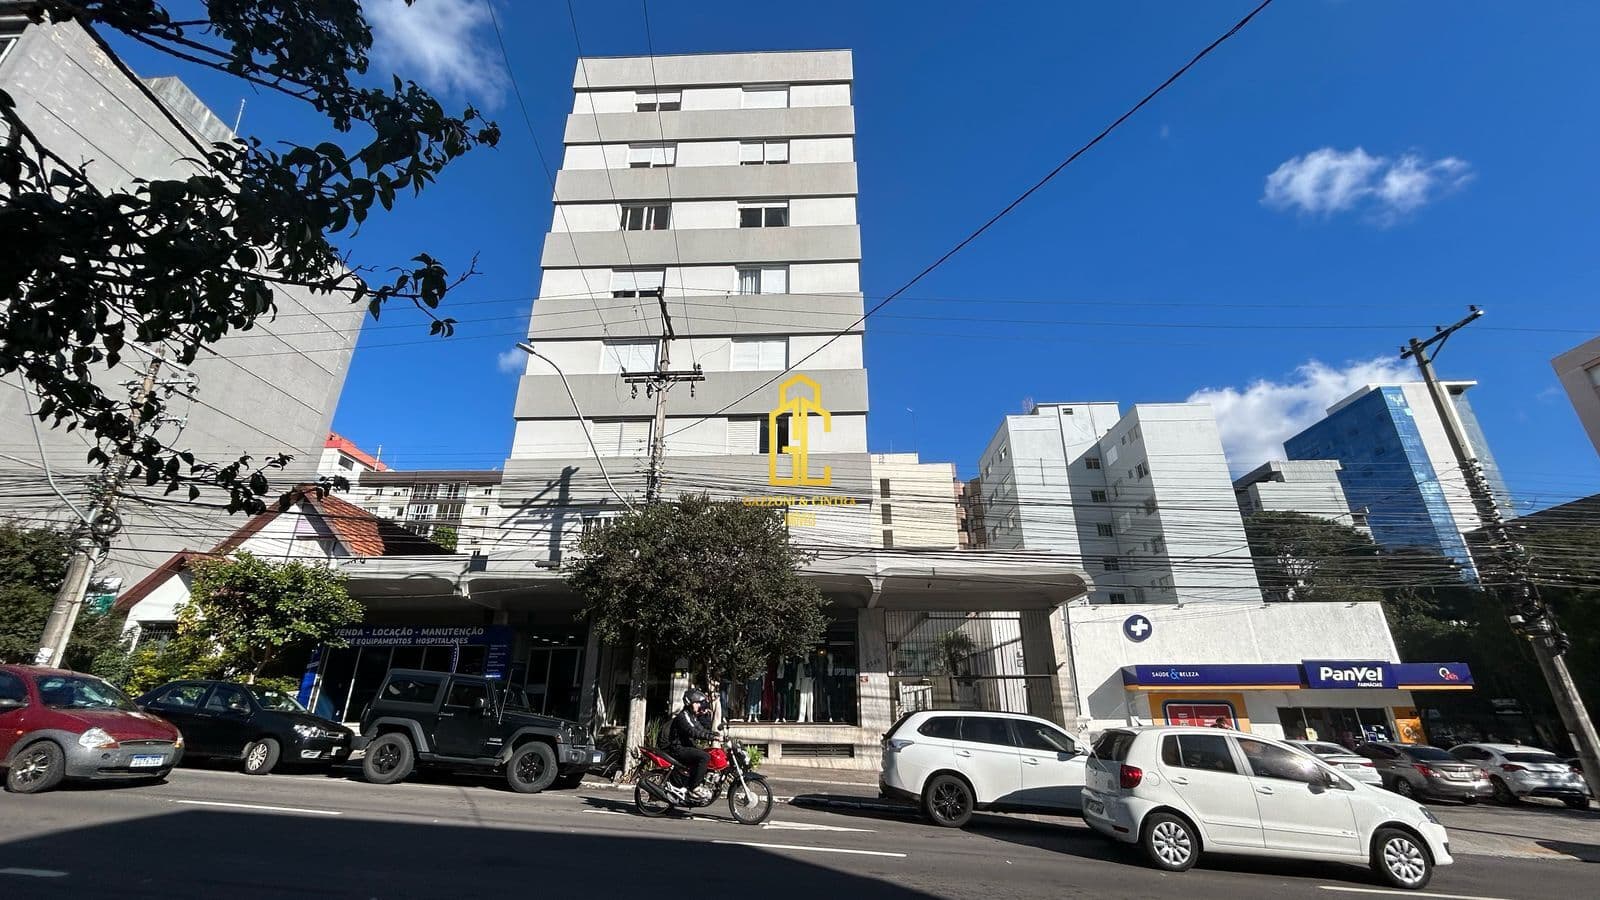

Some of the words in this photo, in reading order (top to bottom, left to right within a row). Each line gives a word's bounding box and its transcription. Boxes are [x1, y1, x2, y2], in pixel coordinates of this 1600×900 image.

[334, 628, 364, 636] VENDA
[371, 626, 414, 637] LOCAÇÃO
[420, 625, 485, 637] MANUTENÇÃO
[356, 637, 412, 645] EQUIPAMENTOS
[415, 637, 469, 645] HOSPITALARES
[1151, 670, 1169, 678] SAÚDE
[1169, 668, 1180, 680] &
[1319, 666, 1383, 681] PanVel
